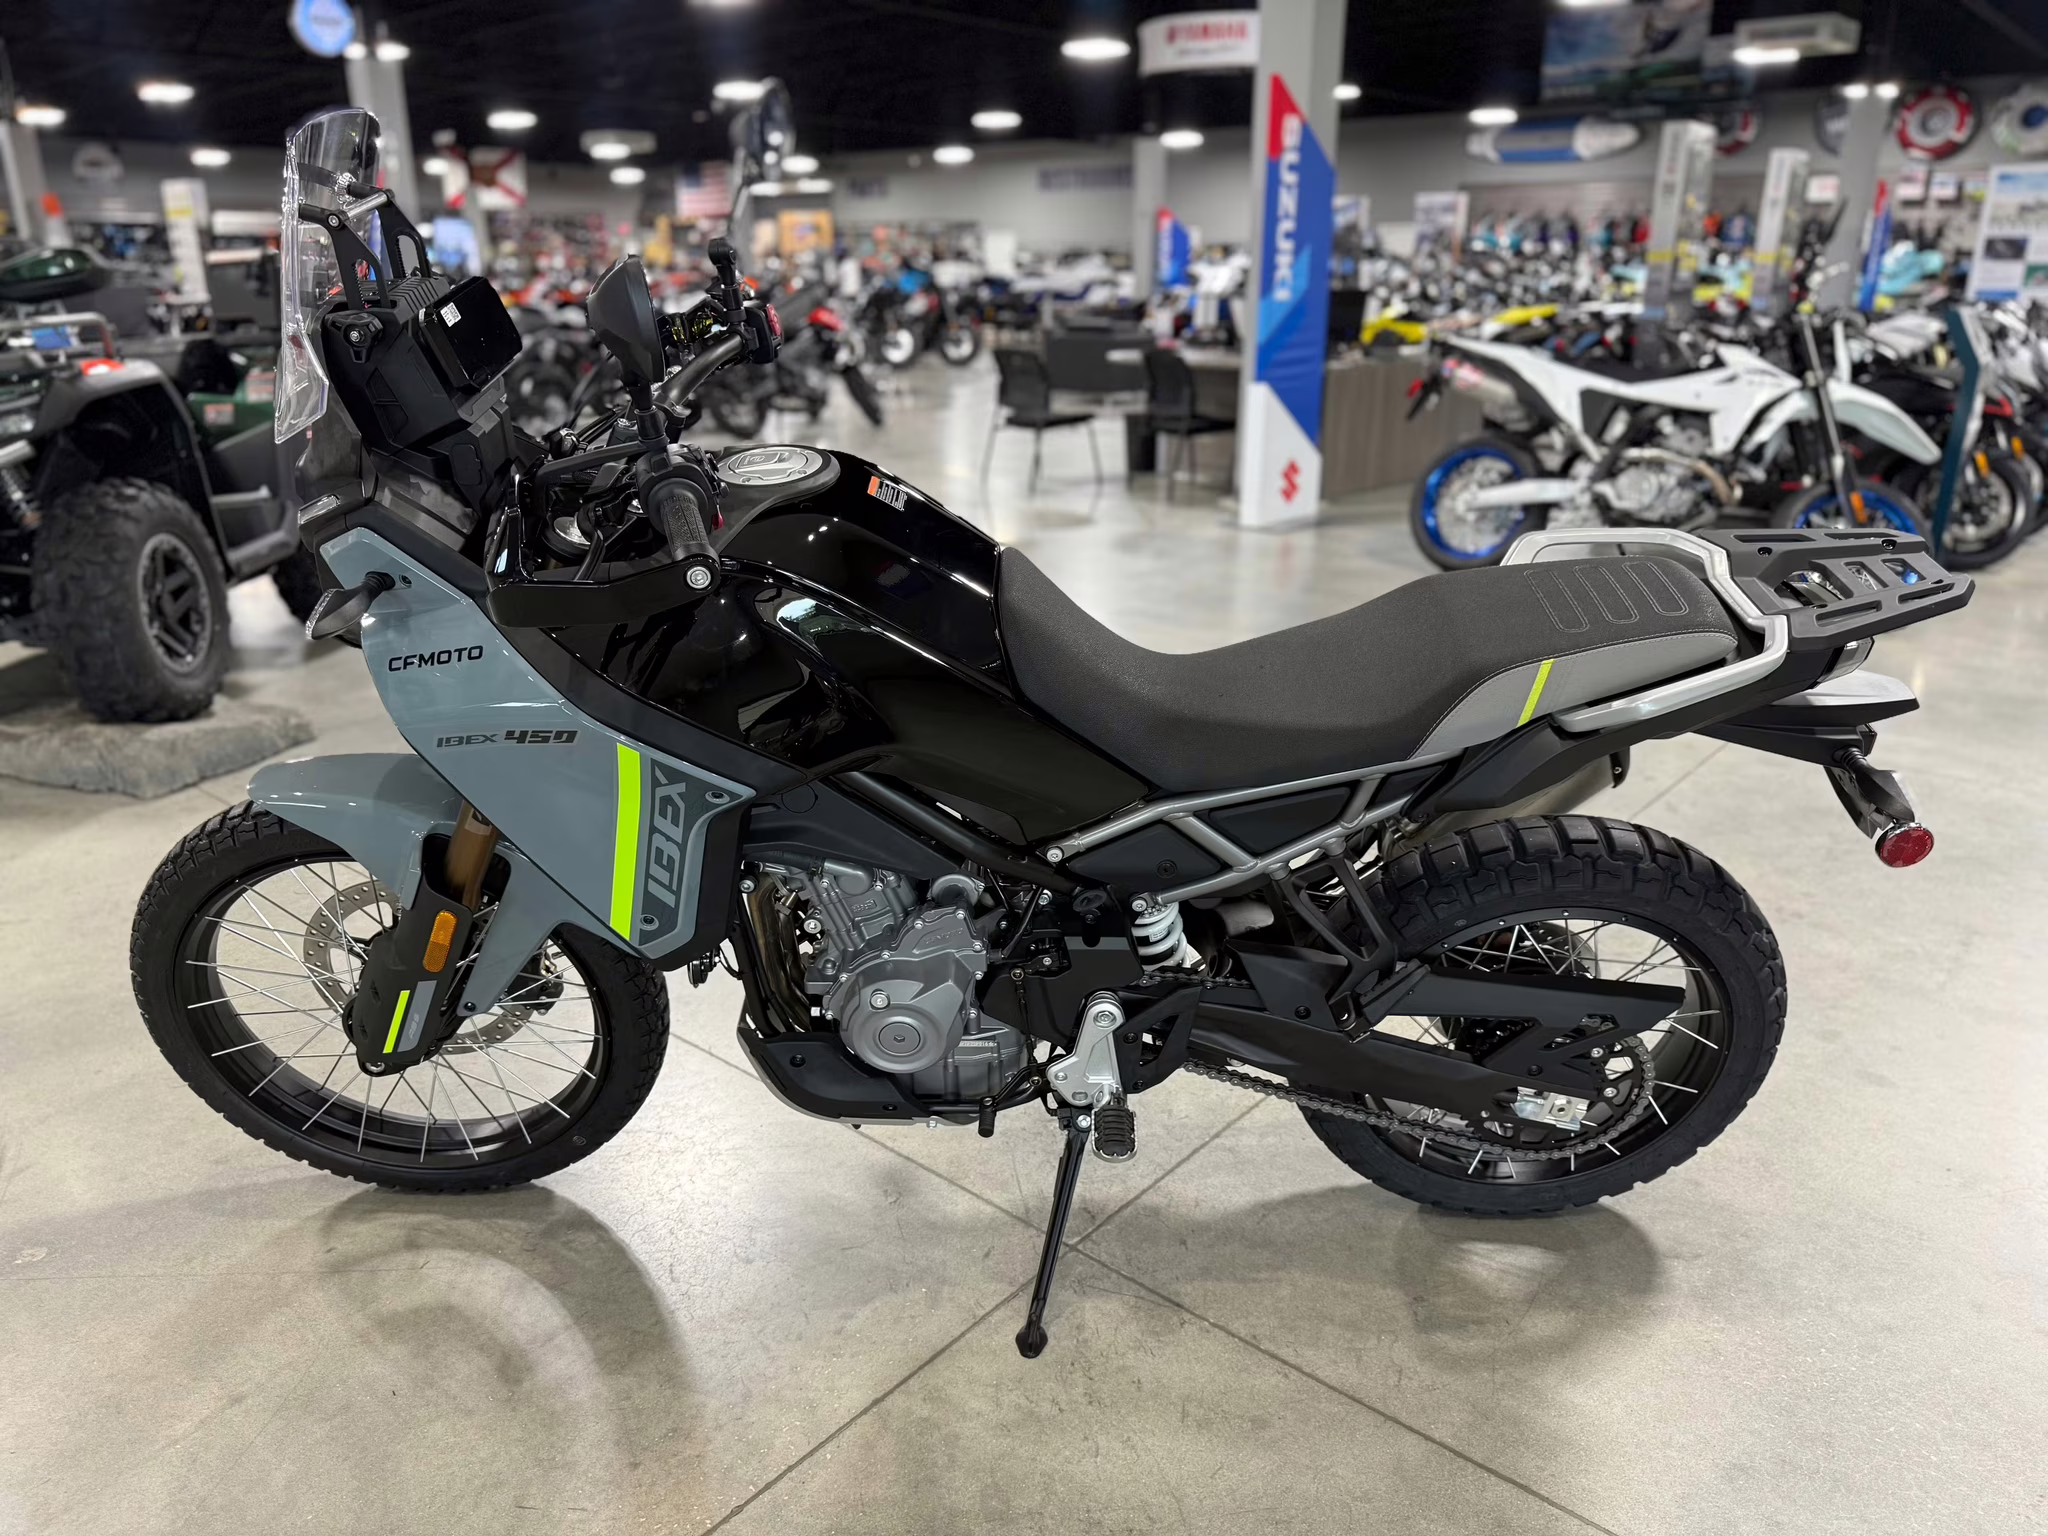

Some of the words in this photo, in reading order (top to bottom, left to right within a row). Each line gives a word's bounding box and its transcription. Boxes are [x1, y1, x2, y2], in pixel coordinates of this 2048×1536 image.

[1274, 112, 1303, 302] SUZUKI
[388, 645, 484, 672] CFMOTO
[436, 733, 499, 748] IBEX
[504, 730, 579, 744] 450
[647, 764, 686, 909] IBEX
